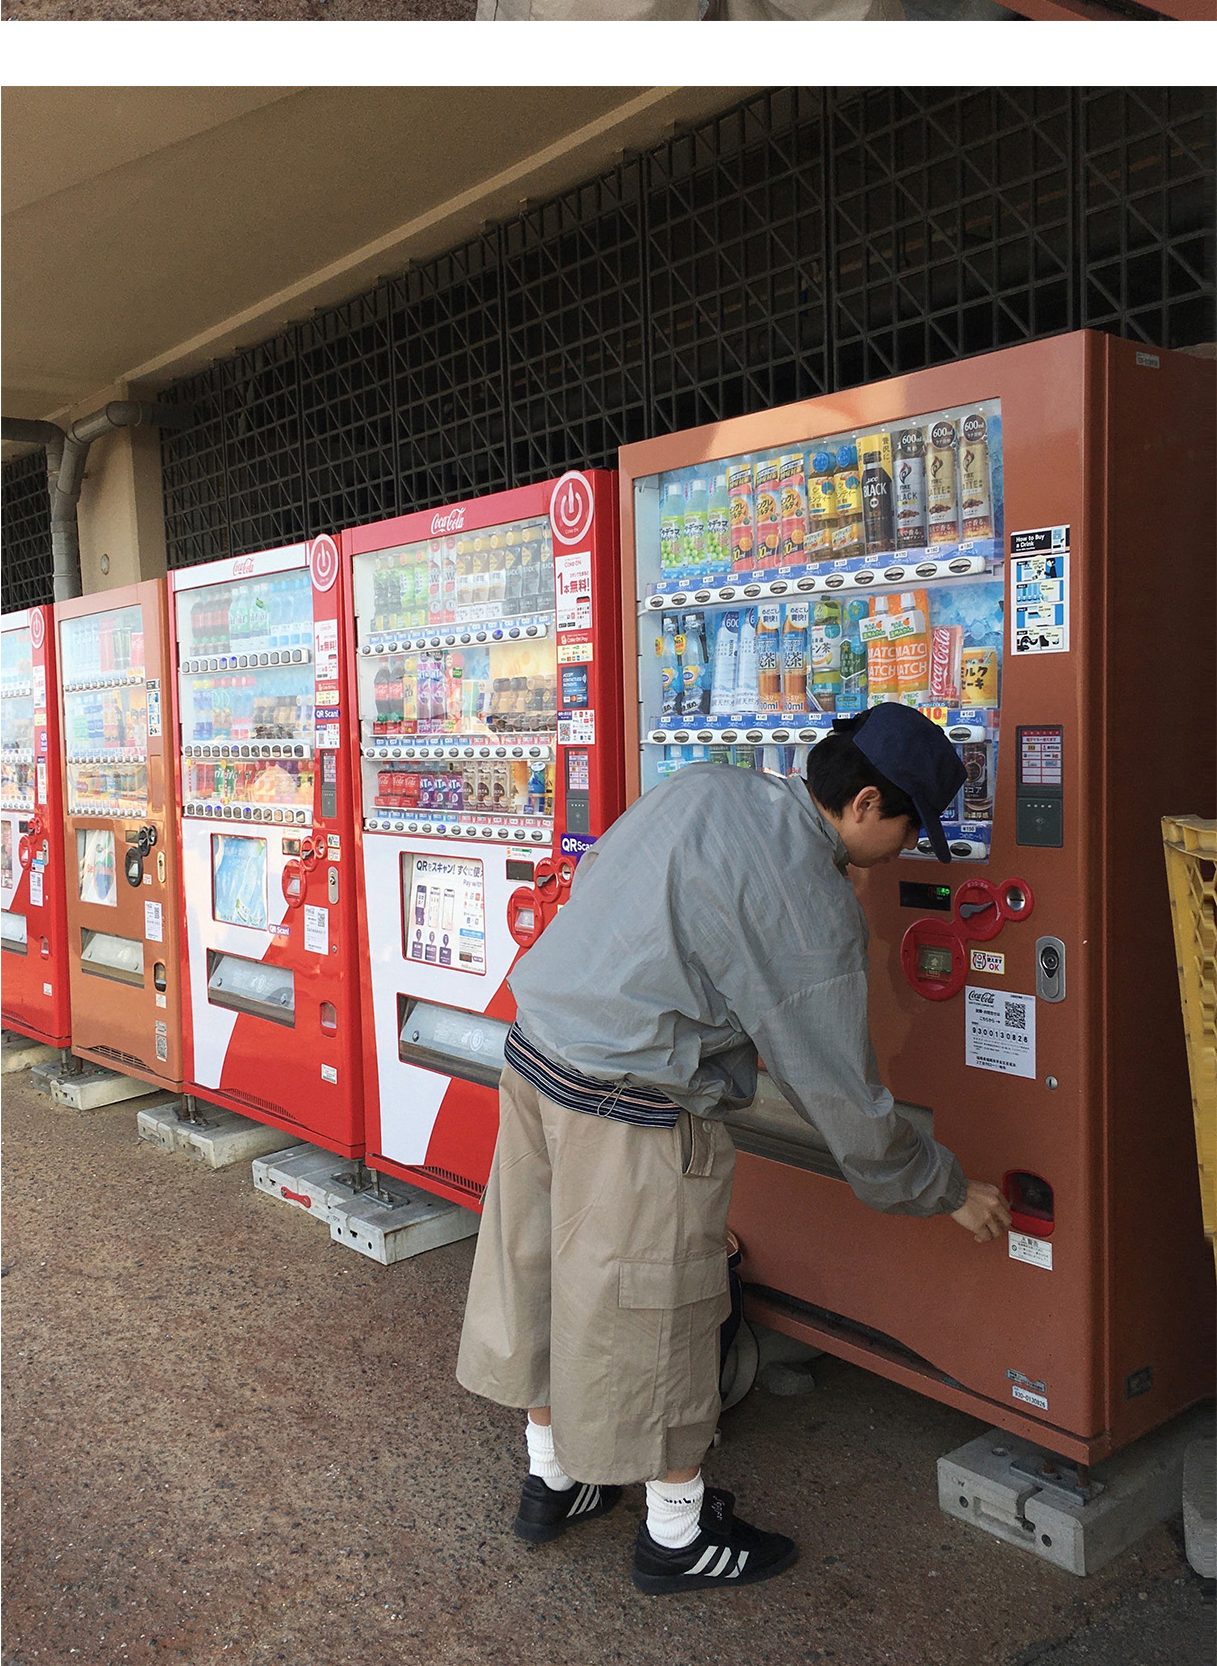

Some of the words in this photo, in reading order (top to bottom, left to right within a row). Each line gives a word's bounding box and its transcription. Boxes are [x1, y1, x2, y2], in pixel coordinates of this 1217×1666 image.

[863, 483, 887, 497] BLACK
[431, 512, 464, 534] Coca-Cola
[558, 572, 590, 595] 1本無料!
[930, 628, 950, 697] Coca-Cola
[316, 710, 324, 718] QR
[325, 709, 339, 718] Scan!
[562, 838, 577, 851] QR
[578, 841, 593, 851] Sca
[968, 990, 995, 1004] Coca-Cola
[972, 1026, 1028, 1043] 9300130826
